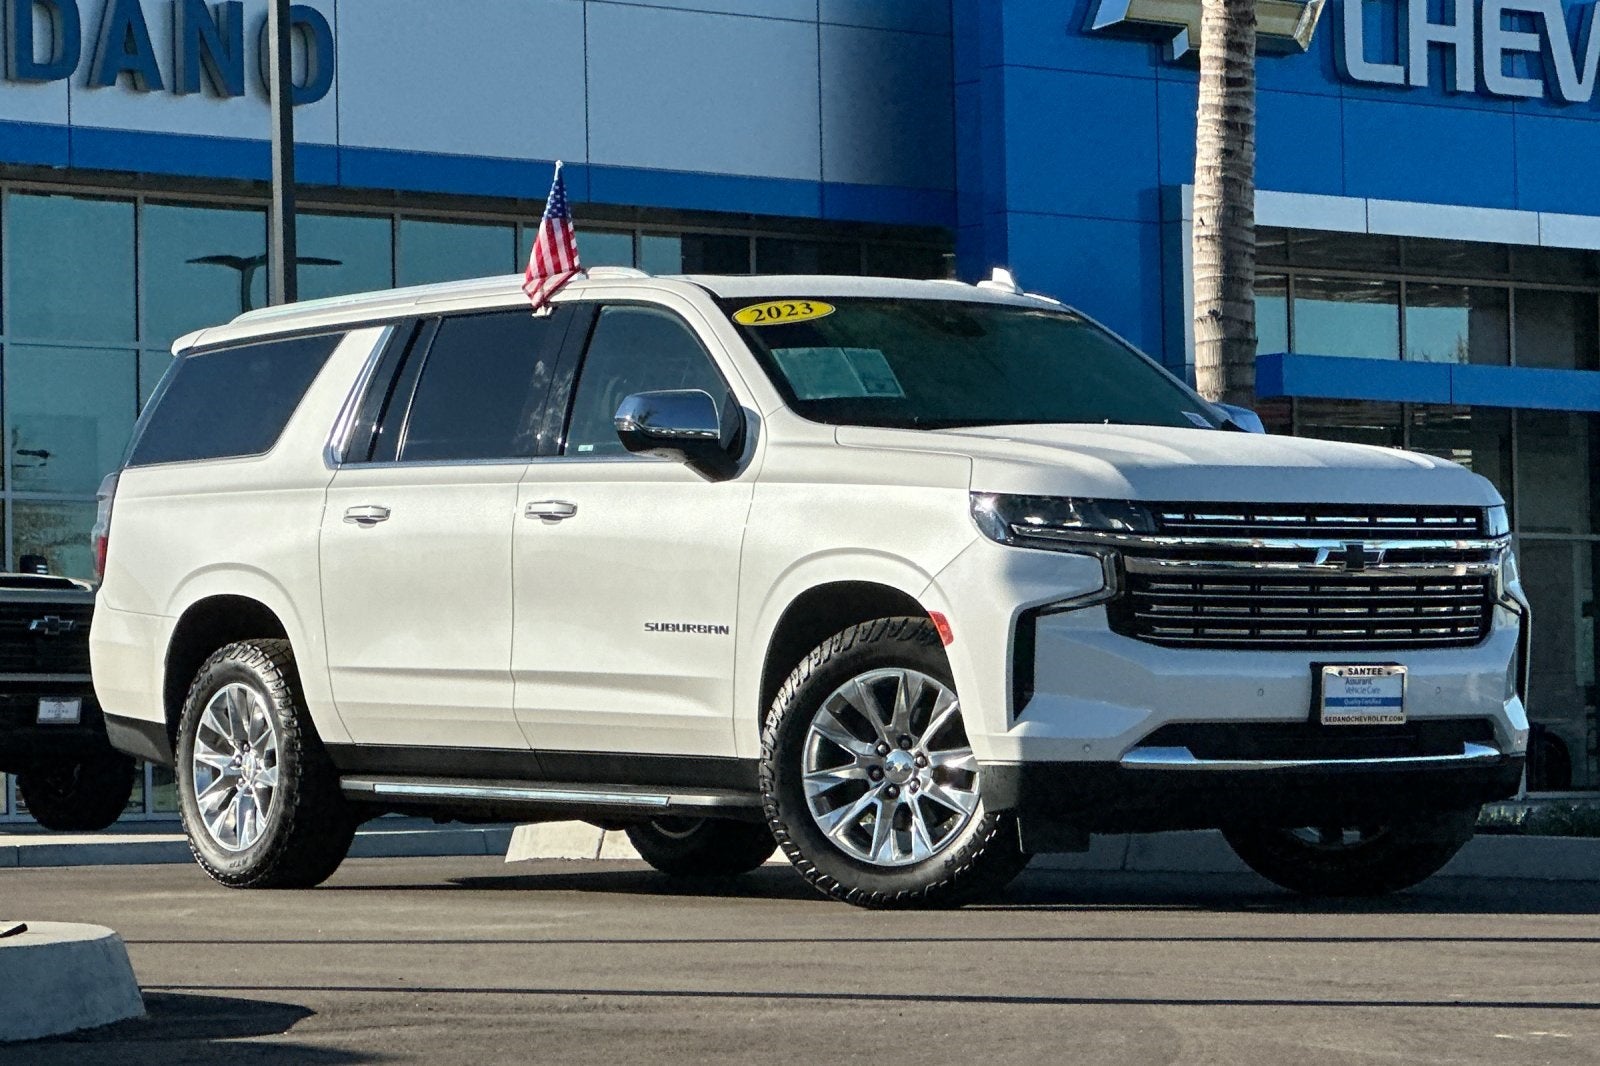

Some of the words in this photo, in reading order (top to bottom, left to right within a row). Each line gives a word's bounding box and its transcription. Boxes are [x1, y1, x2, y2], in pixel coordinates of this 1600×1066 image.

[5, 0, 335, 105] DANO
[750, 302, 814, 323] 2023
[644, 622, 730, 635] SUBURBAN
[1347, 667, 1383, 676] SANTEE
[1324, 715, 1404, 723] SEDANOCHEVROLET.COM
